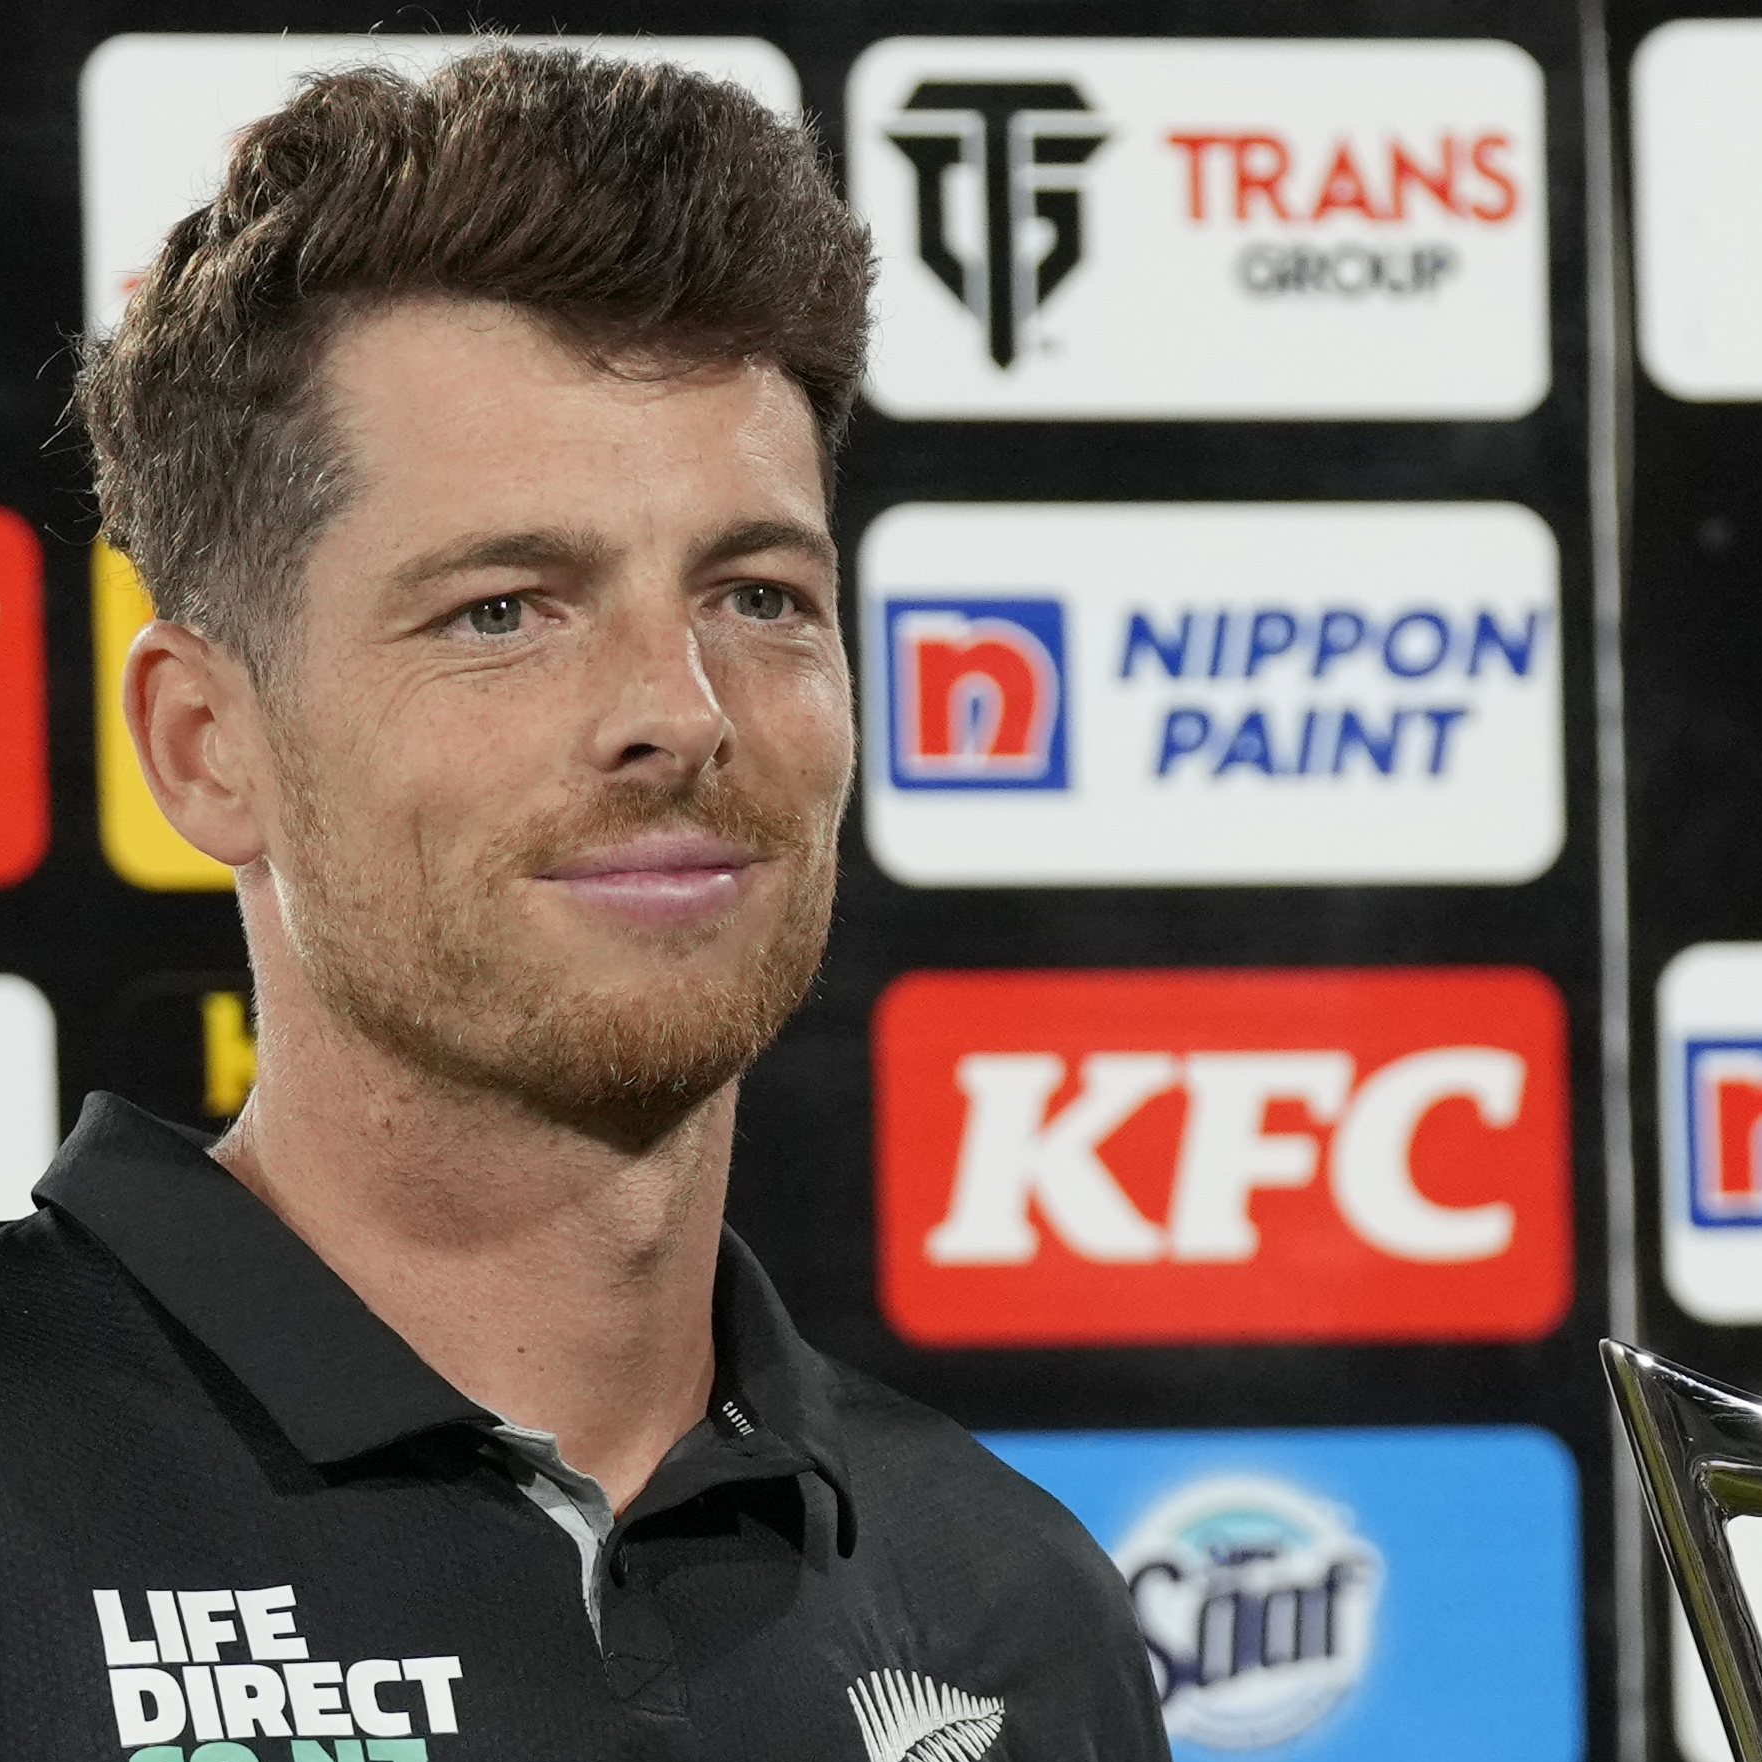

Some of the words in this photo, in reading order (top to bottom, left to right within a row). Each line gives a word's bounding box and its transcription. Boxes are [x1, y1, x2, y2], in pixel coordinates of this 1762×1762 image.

[1168, 130, 1520, 225] TRANS
[1237, 245, 1457, 300] GROUP
[1118, 605, 1547, 683] NIPPON
[1155, 706, 1471, 781] PAINT
[923, 1045, 1527, 1265] KFC
[92, 1585, 309, 1665] LIFE
[107, 1655, 462, 1747] DIRECT
